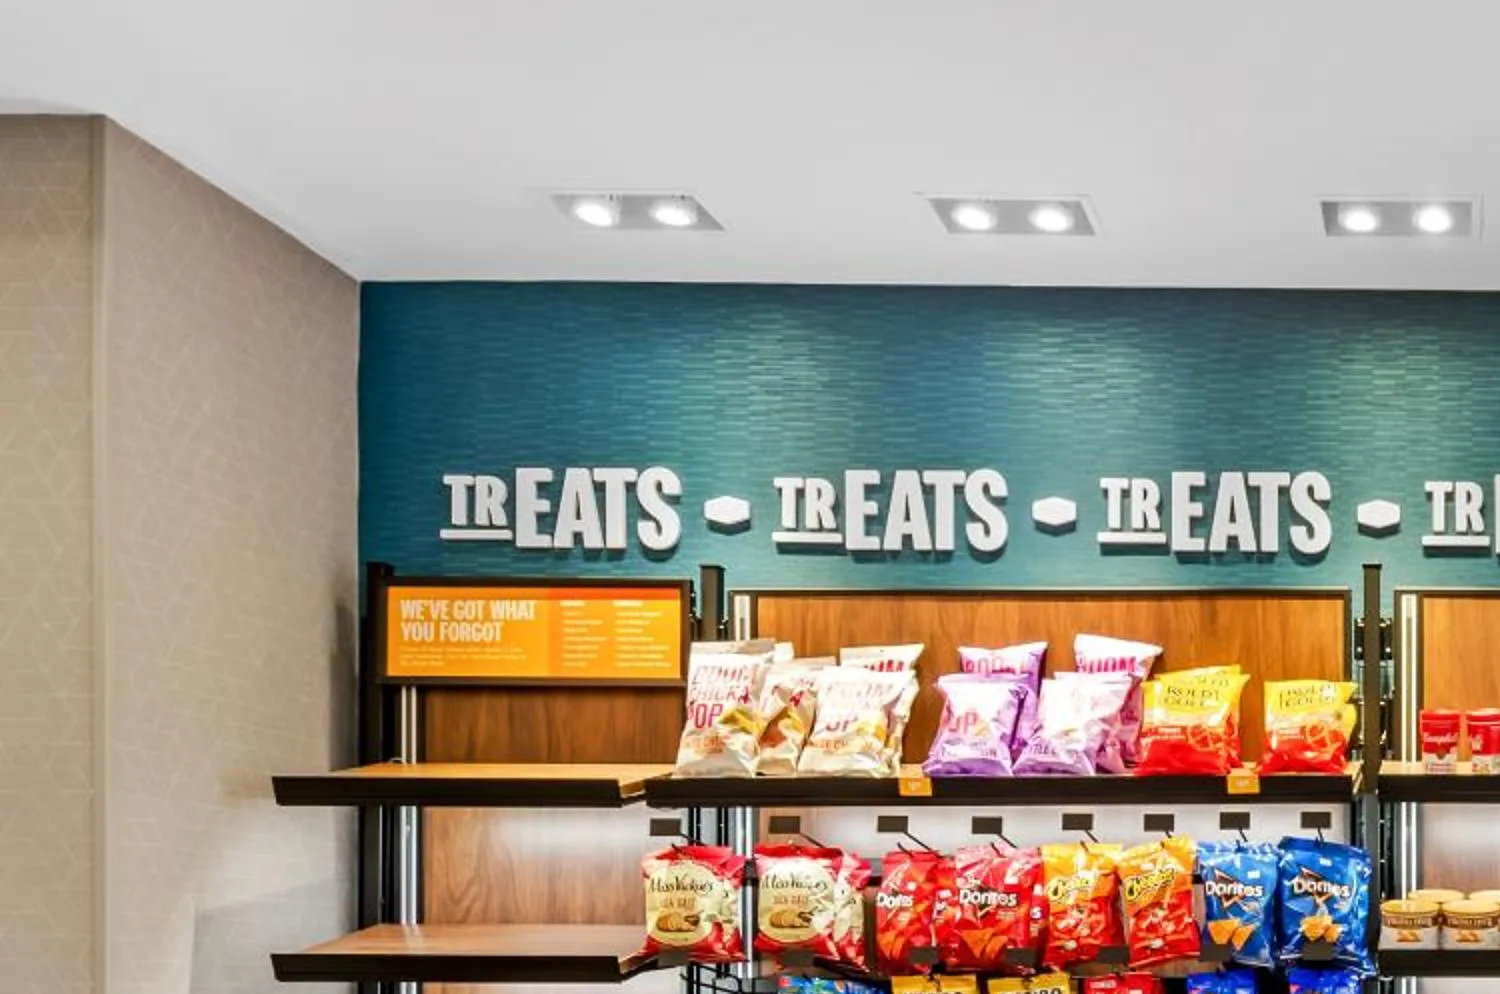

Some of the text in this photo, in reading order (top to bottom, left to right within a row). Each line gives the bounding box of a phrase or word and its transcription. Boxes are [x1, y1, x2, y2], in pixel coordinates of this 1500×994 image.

[440, 467, 682, 551] TREATS
[772, 469, 1009, 552] TREATS
[1097, 471, 1332, 555] TREATS
[400, 600, 538, 620] WE'VE GOT WHAT
[400, 622, 503, 642] YOU FORGOT
[1205, 881, 1263, 898] Doritos
[1293, 877, 1350, 898] Doritos
[959, 889, 1017, 907] Doritos
